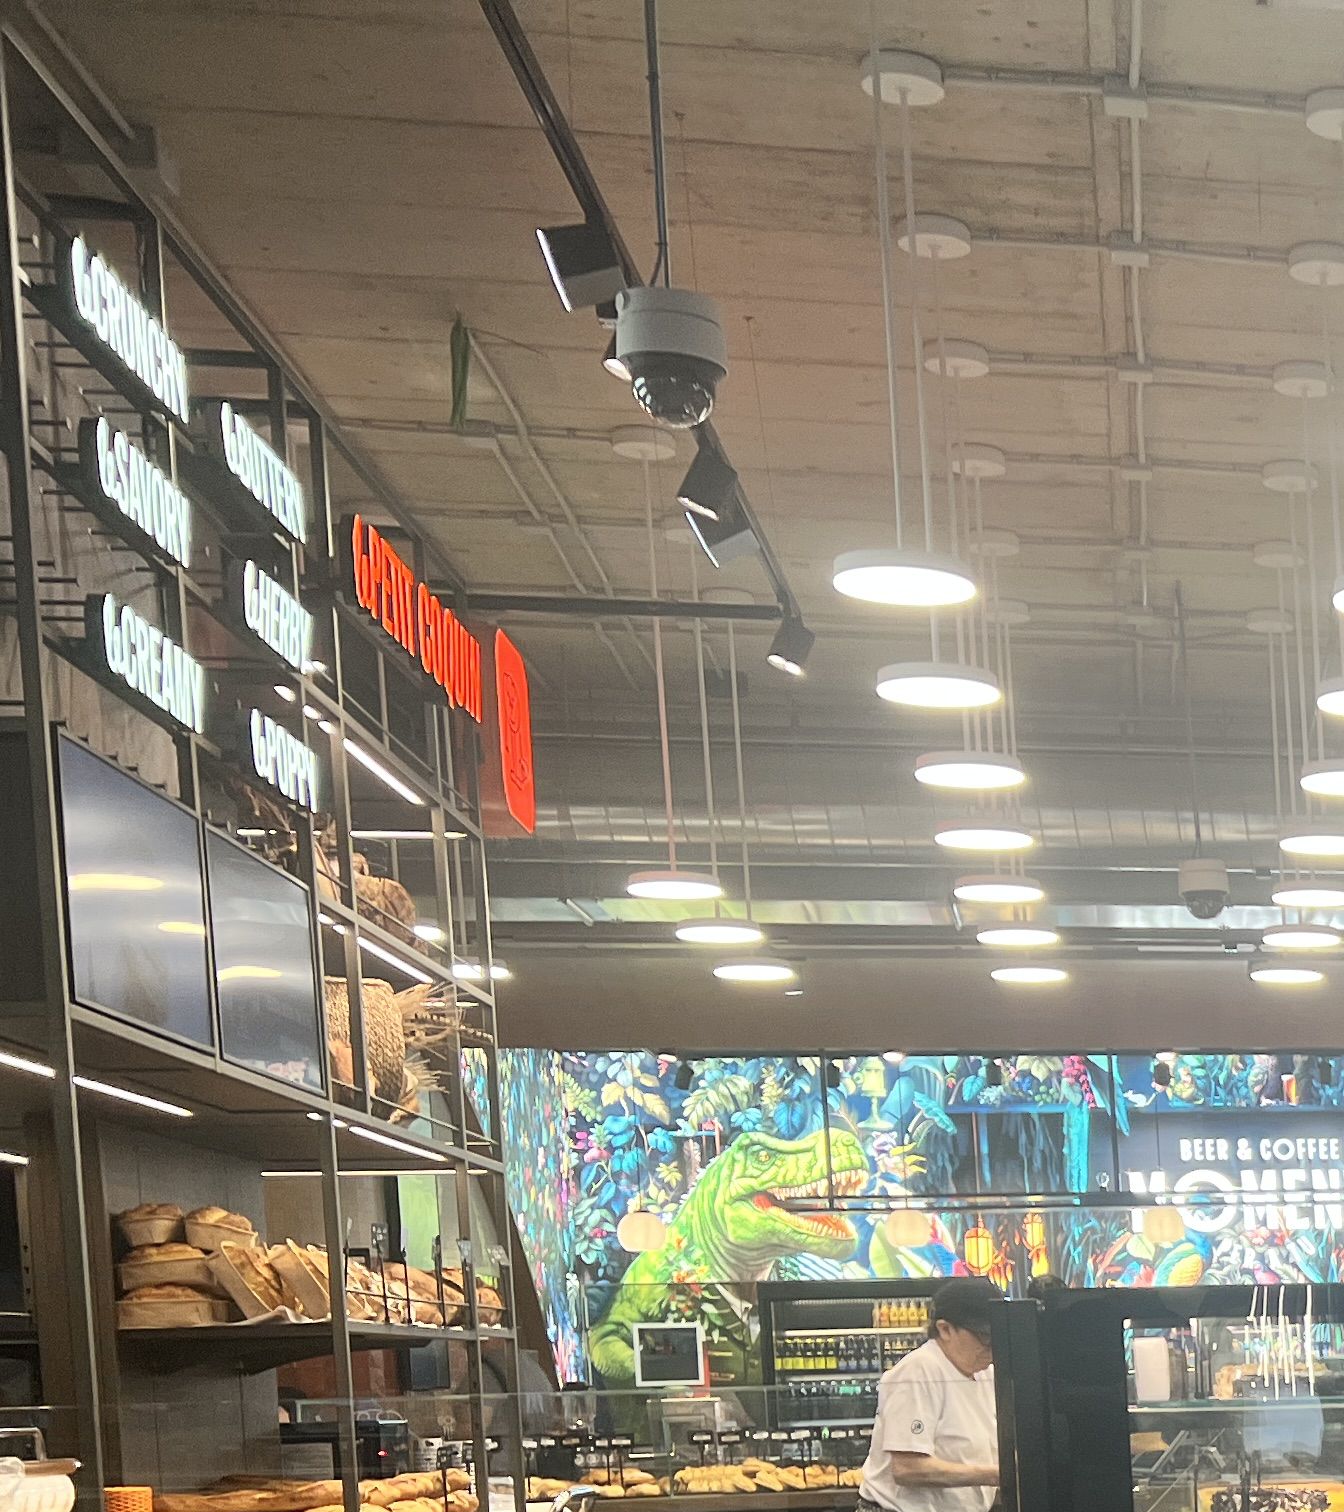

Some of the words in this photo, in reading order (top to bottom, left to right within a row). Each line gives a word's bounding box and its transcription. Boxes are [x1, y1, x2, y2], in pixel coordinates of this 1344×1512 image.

[1179, 1138, 1229, 1161] BEER
[1236, 1137, 1252, 1161] &
[1259, 1137, 1340, 1161] COFFEE
